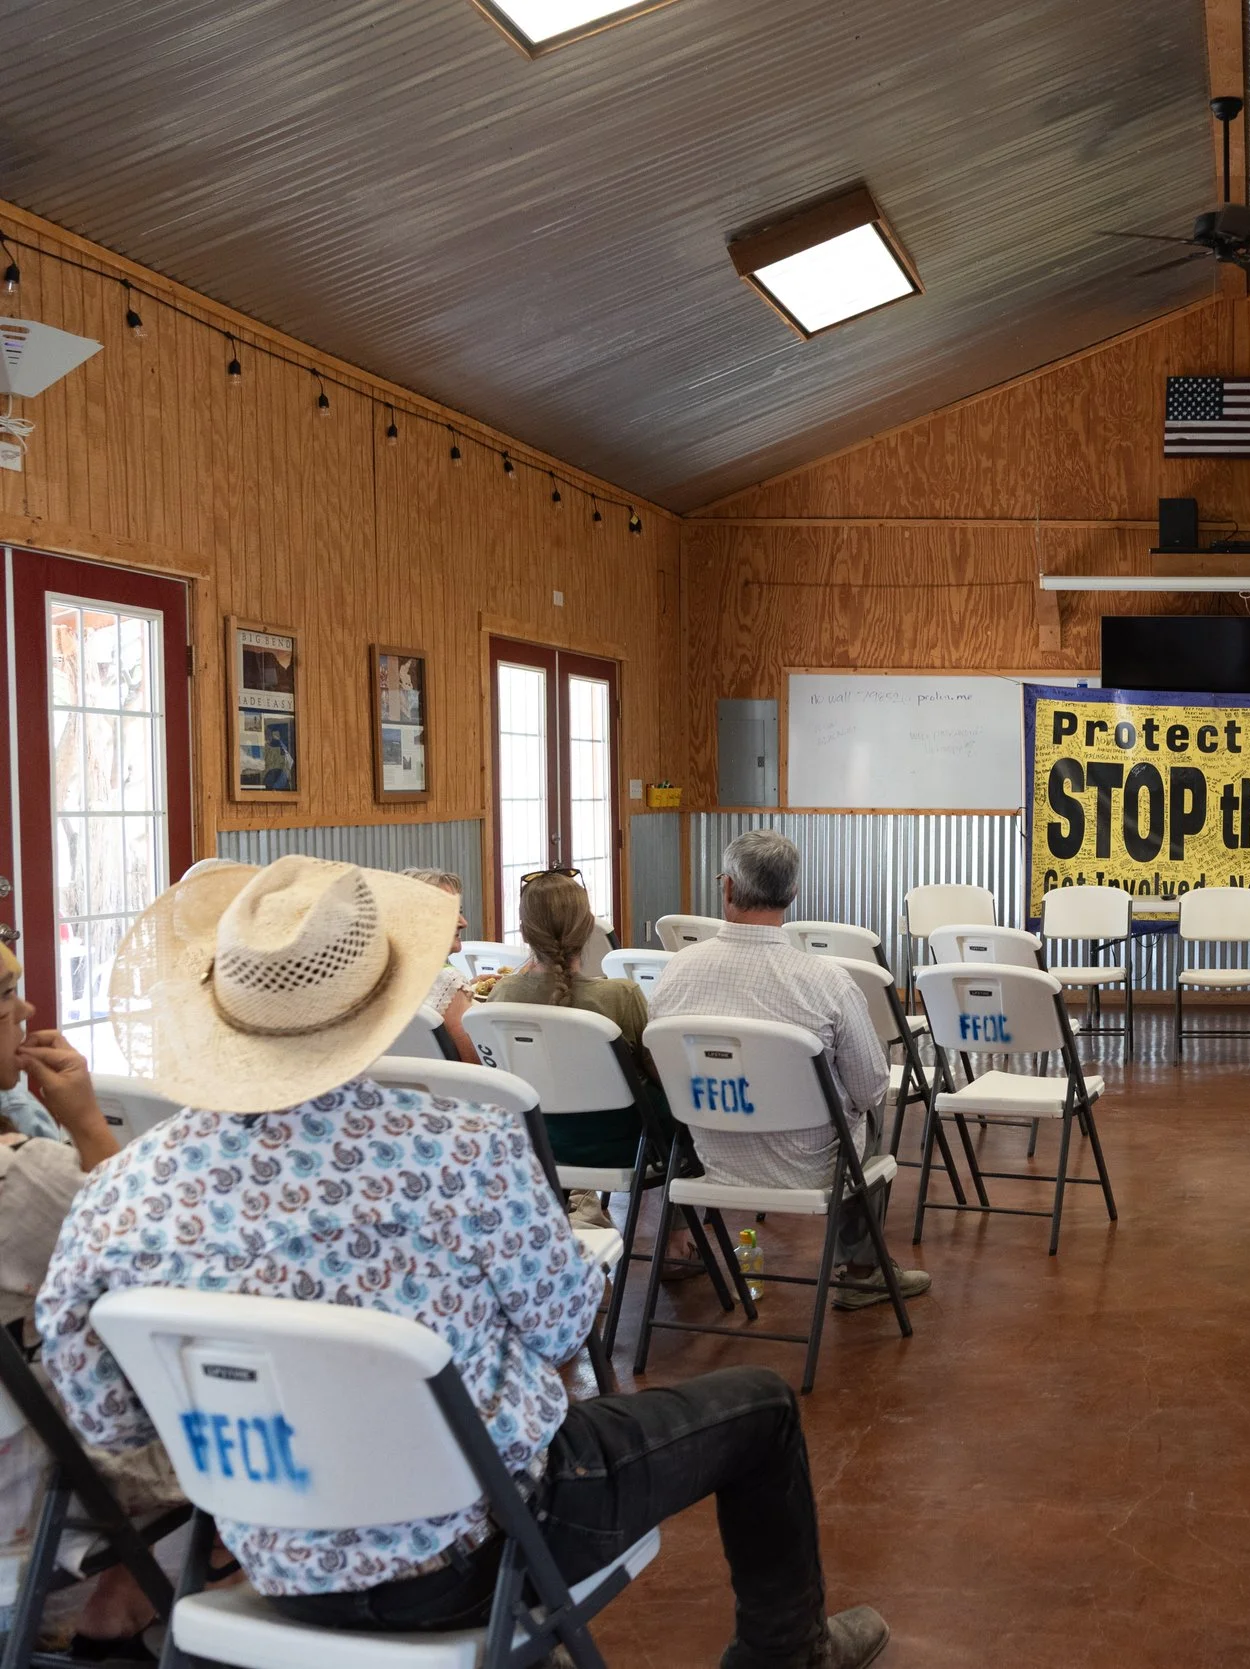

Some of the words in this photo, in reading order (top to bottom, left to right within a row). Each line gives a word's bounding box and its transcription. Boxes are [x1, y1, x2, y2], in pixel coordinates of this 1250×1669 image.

[241, 631, 261, 644] BIG
[265, 636, 292, 649] BEND
[266, 698, 292, 710] EASY
[1053, 711, 1242, 753] Protect
[1048, 758, 1207, 862] STOP
